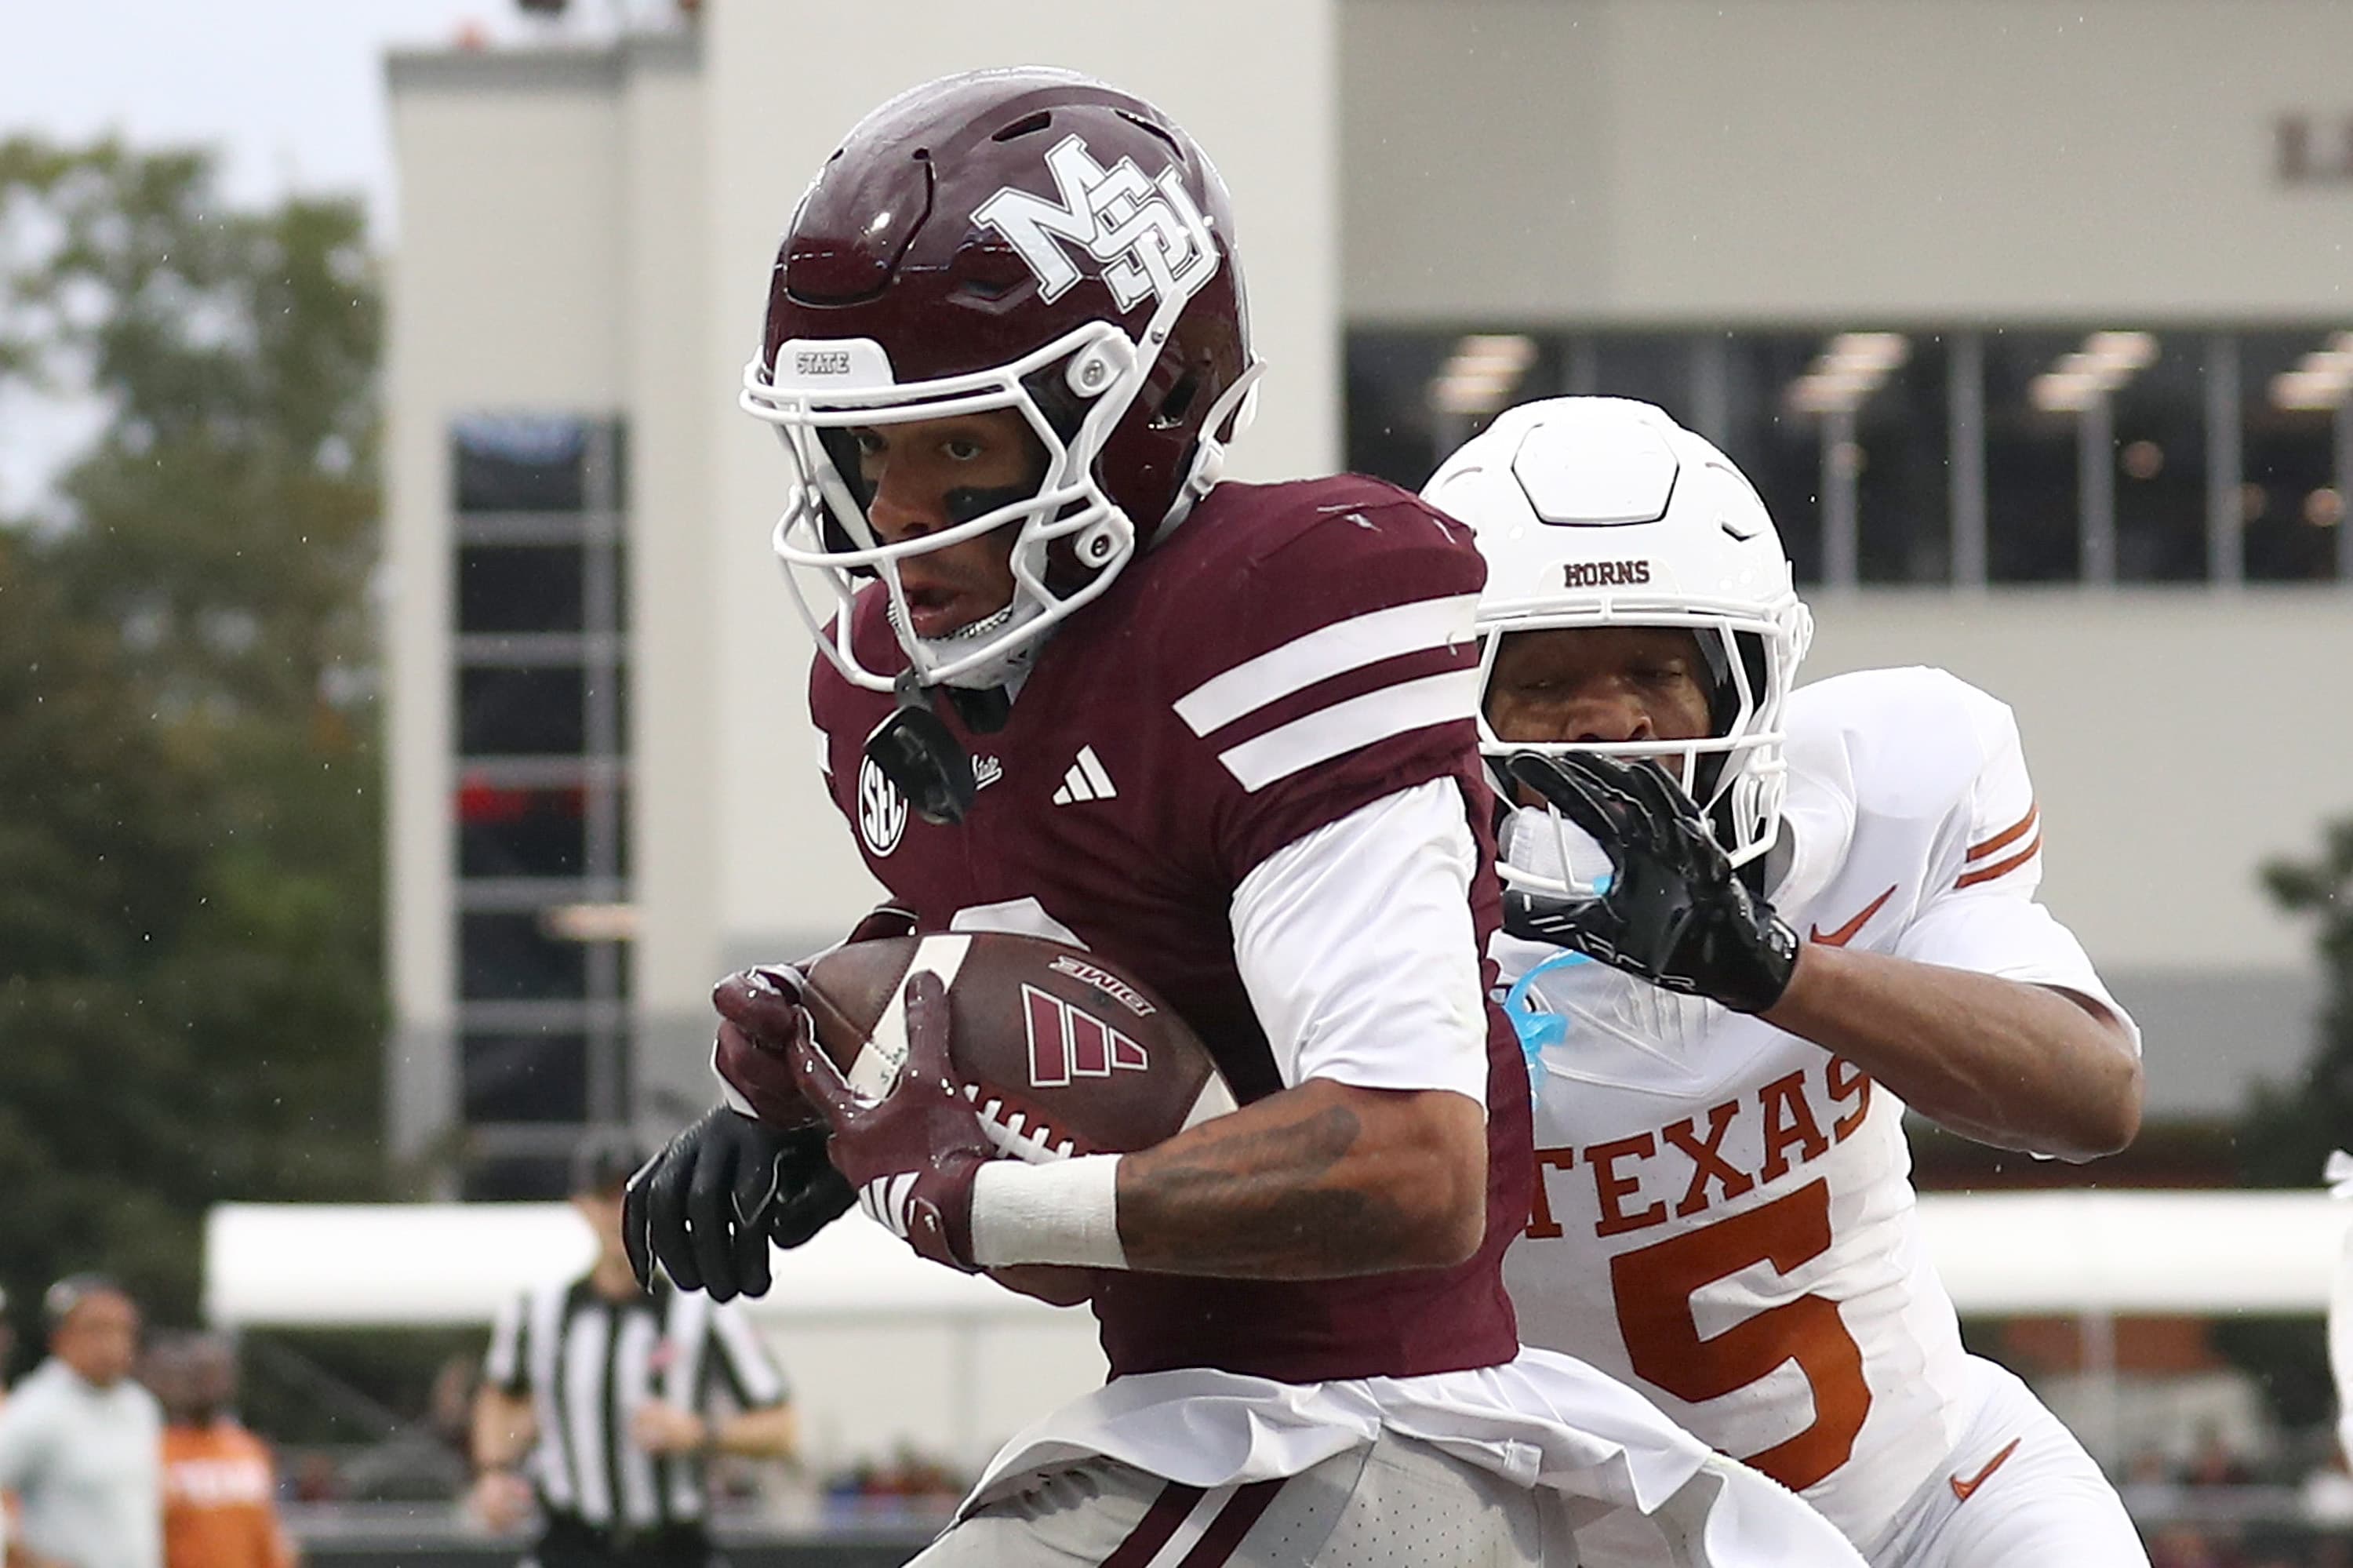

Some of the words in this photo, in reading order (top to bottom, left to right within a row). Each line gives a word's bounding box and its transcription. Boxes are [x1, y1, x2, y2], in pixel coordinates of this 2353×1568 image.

[969, 133, 1220, 315] MSU
[796, 351, 849, 375] STATE
[1563, 560, 1650, 588] HORNS
[1526, 1053, 1872, 1241] TEXAS
[1609, 1175, 1874, 1493] 5
